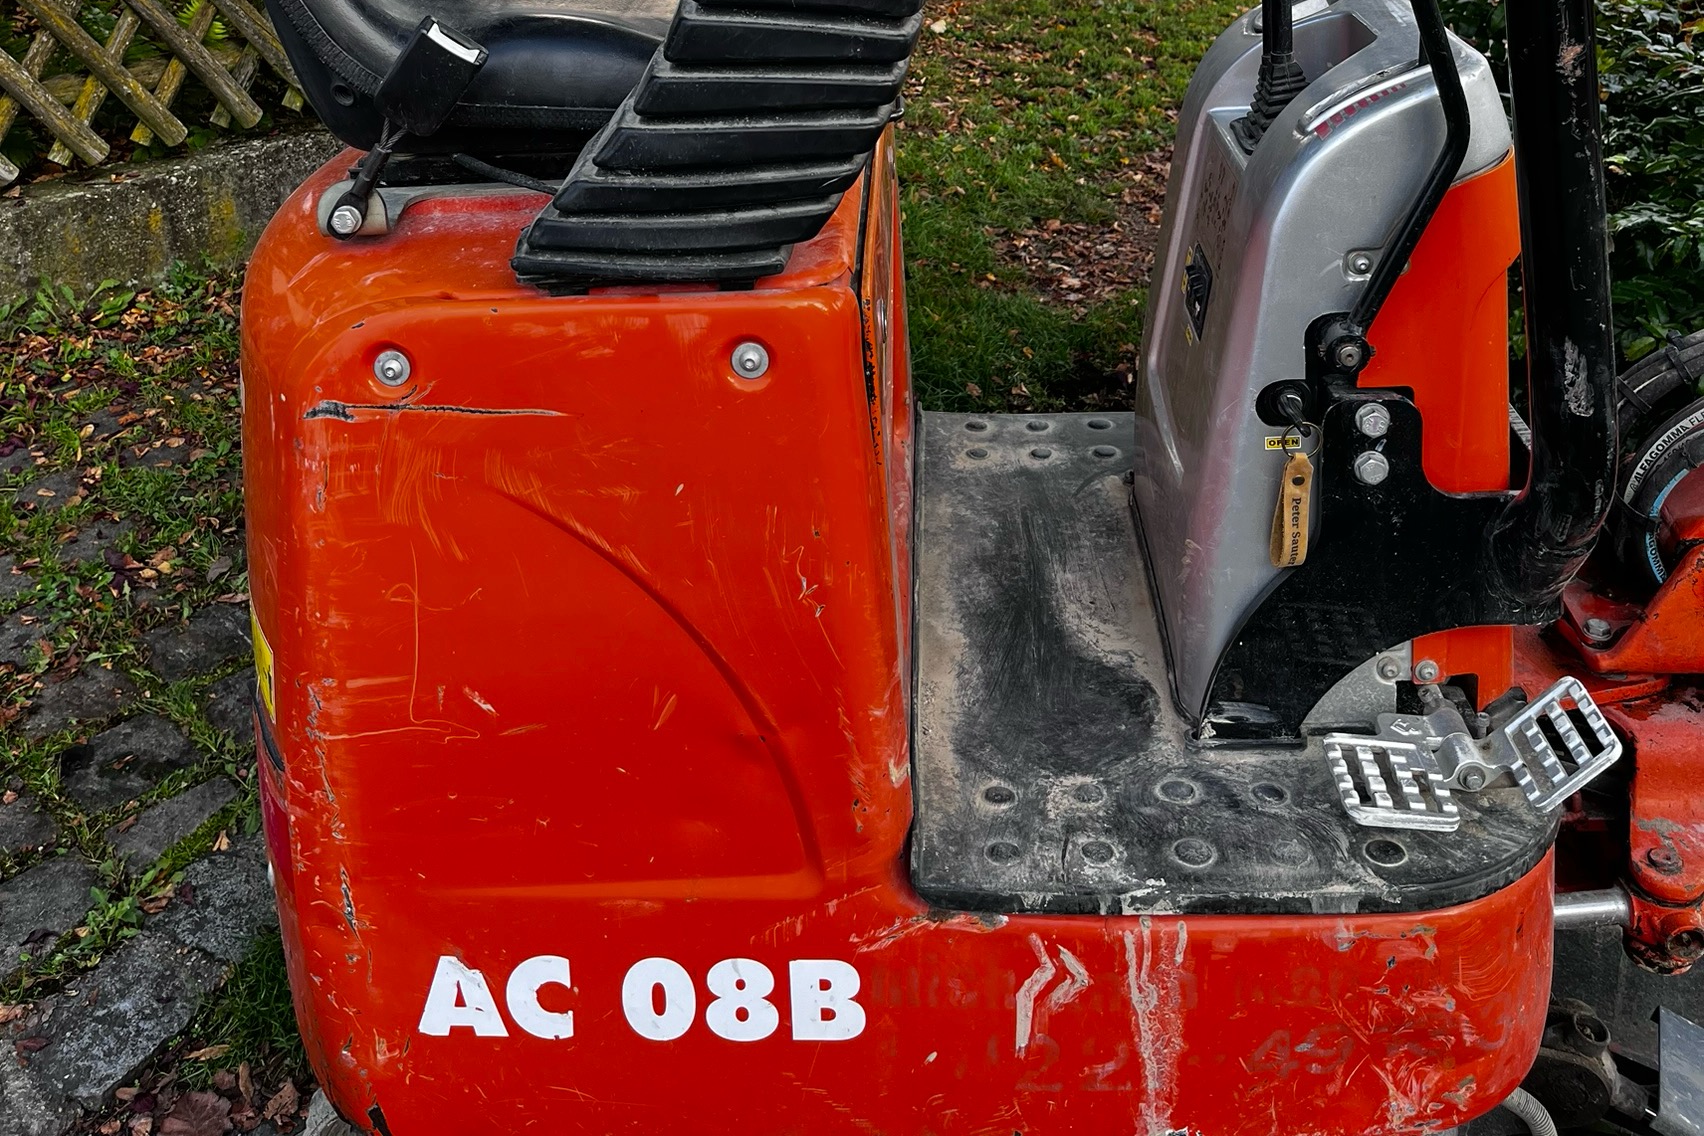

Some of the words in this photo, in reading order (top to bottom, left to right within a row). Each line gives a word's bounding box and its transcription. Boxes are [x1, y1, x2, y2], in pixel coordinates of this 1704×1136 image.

[1268, 439, 1299, 447] OPEN
[1634, 425, 1690, 483] ALFAGOMMA
[1291, 497, 1302, 529] Peter
[417, 955, 575, 1040] AC
[621, 956, 867, 1042] 08B
